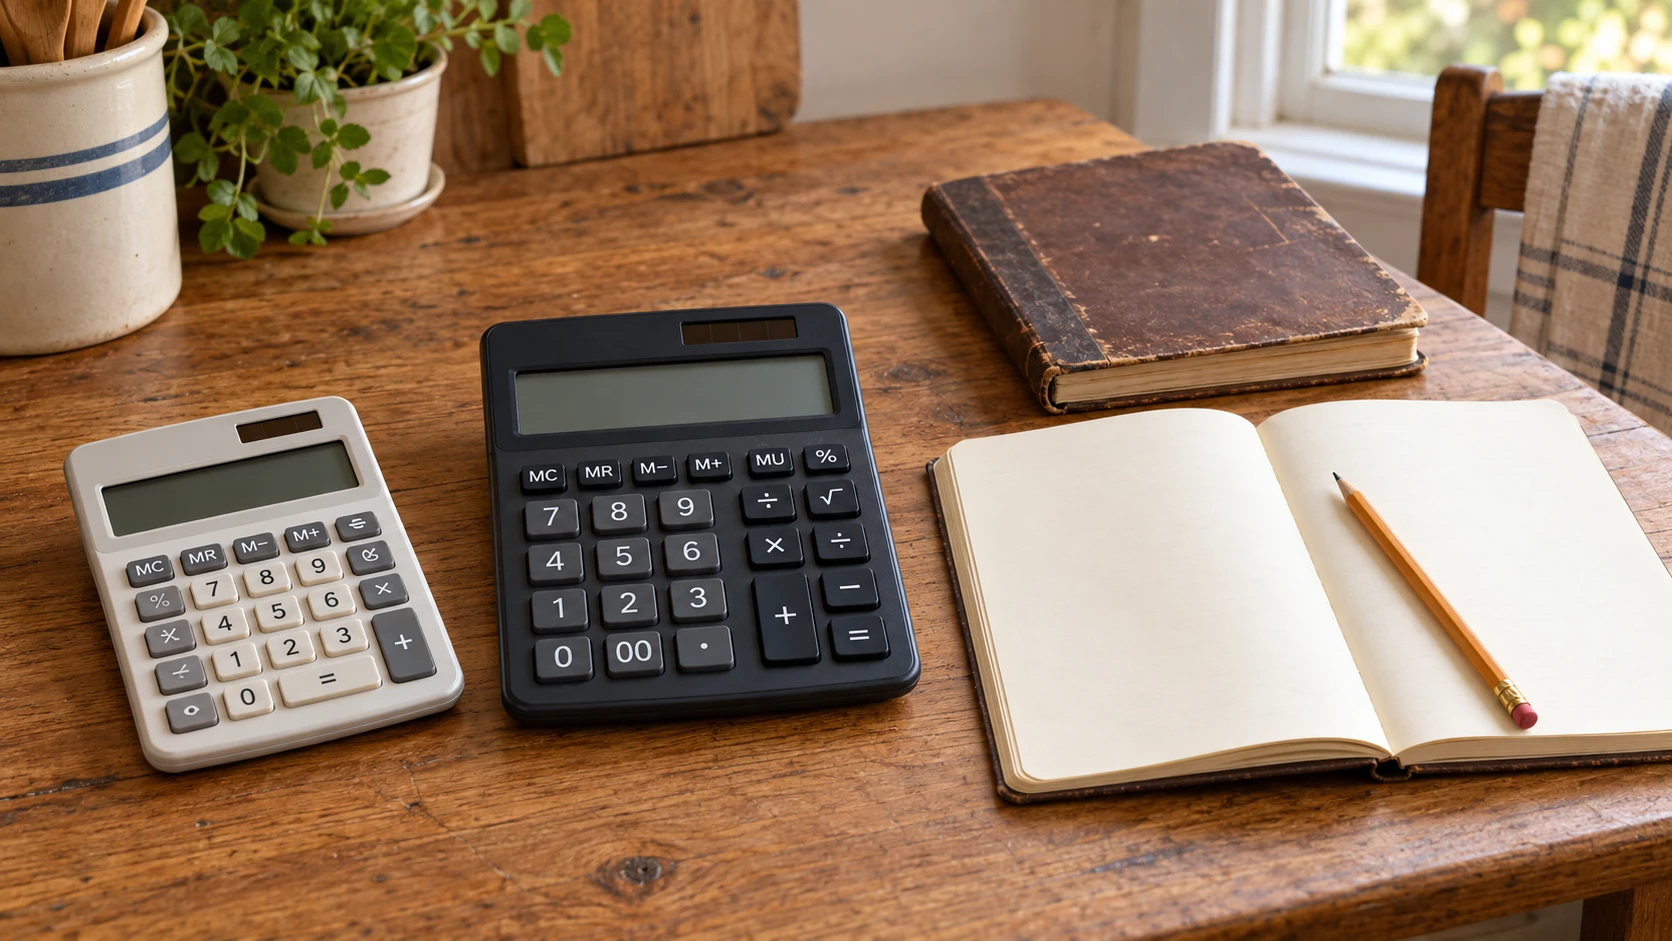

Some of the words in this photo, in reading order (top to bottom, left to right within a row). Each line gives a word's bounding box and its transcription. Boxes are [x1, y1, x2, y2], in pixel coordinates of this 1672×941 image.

[529, 469, 558, 482] MC
[585, 465, 613, 478] MR
[695, 459, 723, 470] M+
[755, 453, 785, 466] MU
[815, 449, 837, 463] %
[543, 506, 559, 526] 7
[611, 502, 628, 521] 8
[677, 497, 694, 516] 9
[135, 560, 165, 576] MC
[188, 549, 217, 565] MR
[292, 528, 320, 542] M+
[545, 551, 565, 571] 4
[615, 545, 633, 566] 5
[683, 541, 701, 561] 6
[150, 592, 170, 609] %
[205, 580, 219, 597] 7
[259, 569, 275, 585] 8
[311, 558, 326, 574] 9
[218, 615, 233, 631] 4
[271, 602, 286, 620] 5
[324, 591, 339, 608] 6
[552, 597, 565, 618] 1
[619, 592, 638, 614] 2
[689, 586, 707, 608] 3
[230, 651, 241, 668] 1
[283, 638, 300, 656] 2
[336, 627, 352, 643] 3
[554, 645, 573, 668] 0
[615, 640, 652, 663] 00
[848, 629, 870, 641] =
[240, 688, 256, 706] 0
[318, 673, 337, 685] =
